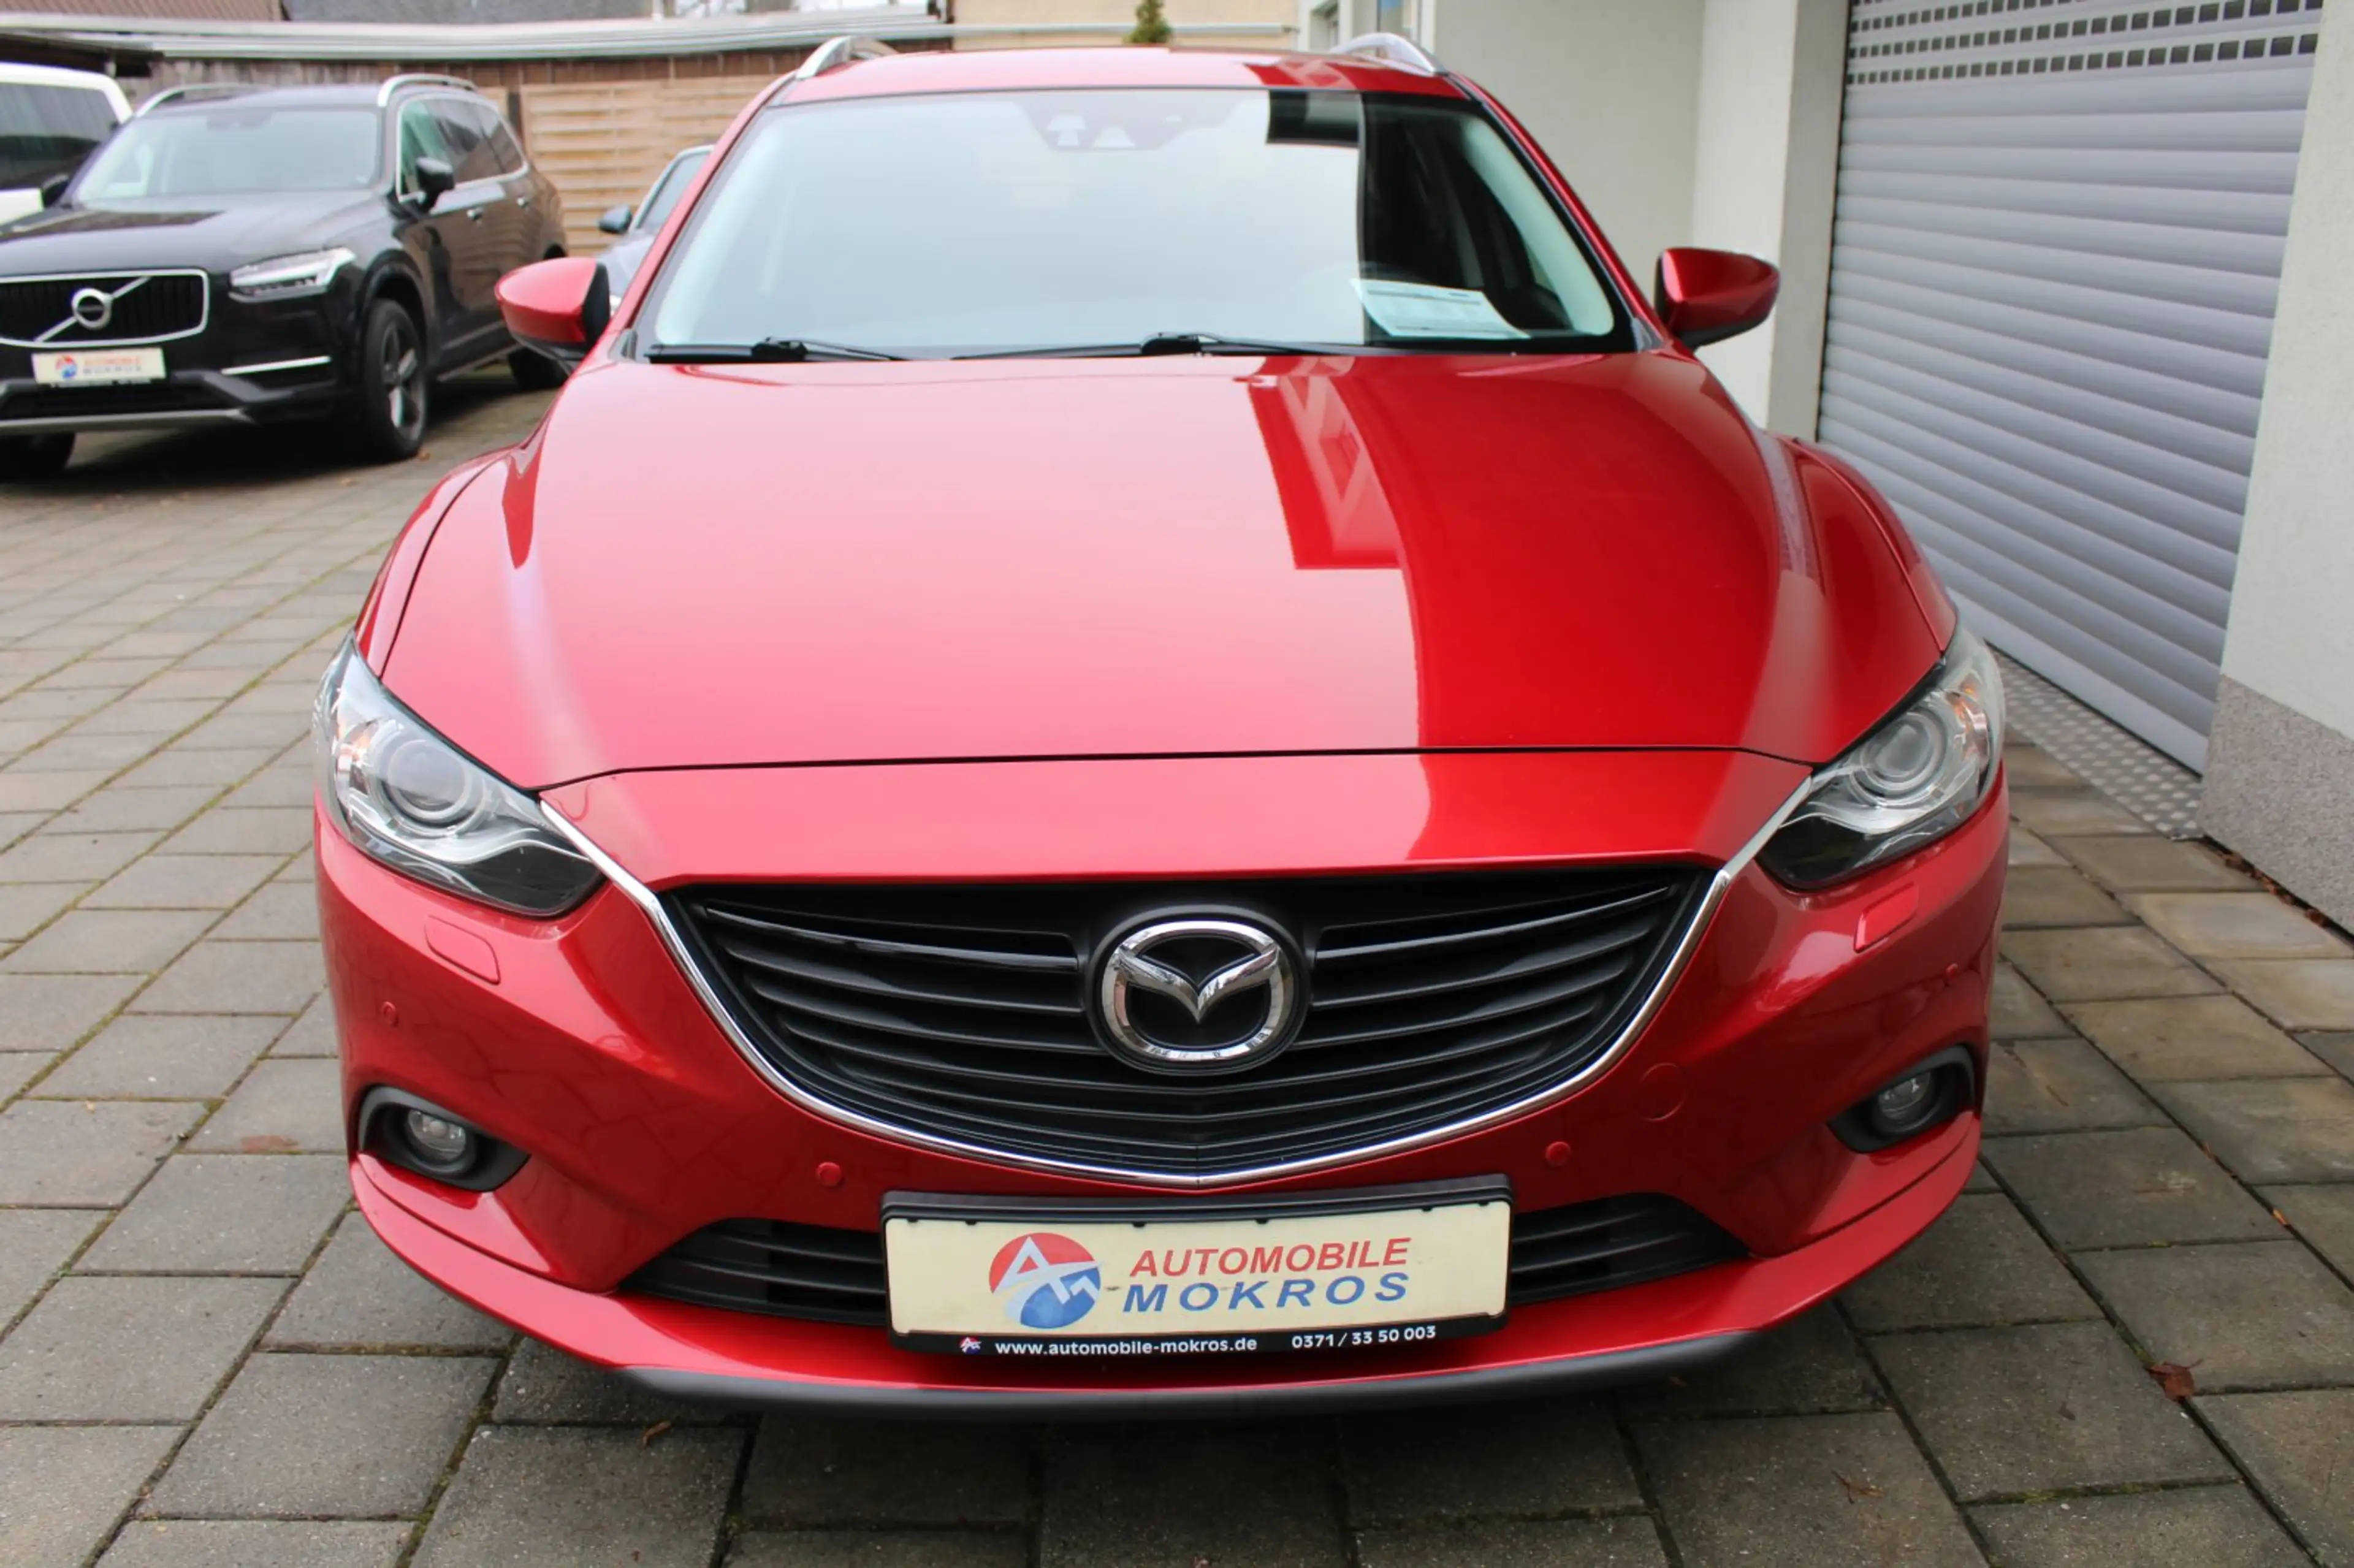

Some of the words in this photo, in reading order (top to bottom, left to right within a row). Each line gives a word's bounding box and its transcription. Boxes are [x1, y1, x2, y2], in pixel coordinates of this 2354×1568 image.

[1130, 1237, 1411, 1277] AUTOMOBILE
[1123, 1272, 1409, 1312] MOKROS
[994, 1338, 1257, 1355] www.automobile-mokros.de
[1377, 1328, 1399, 1343] 50
[1403, 1325, 1436, 1341] 003
